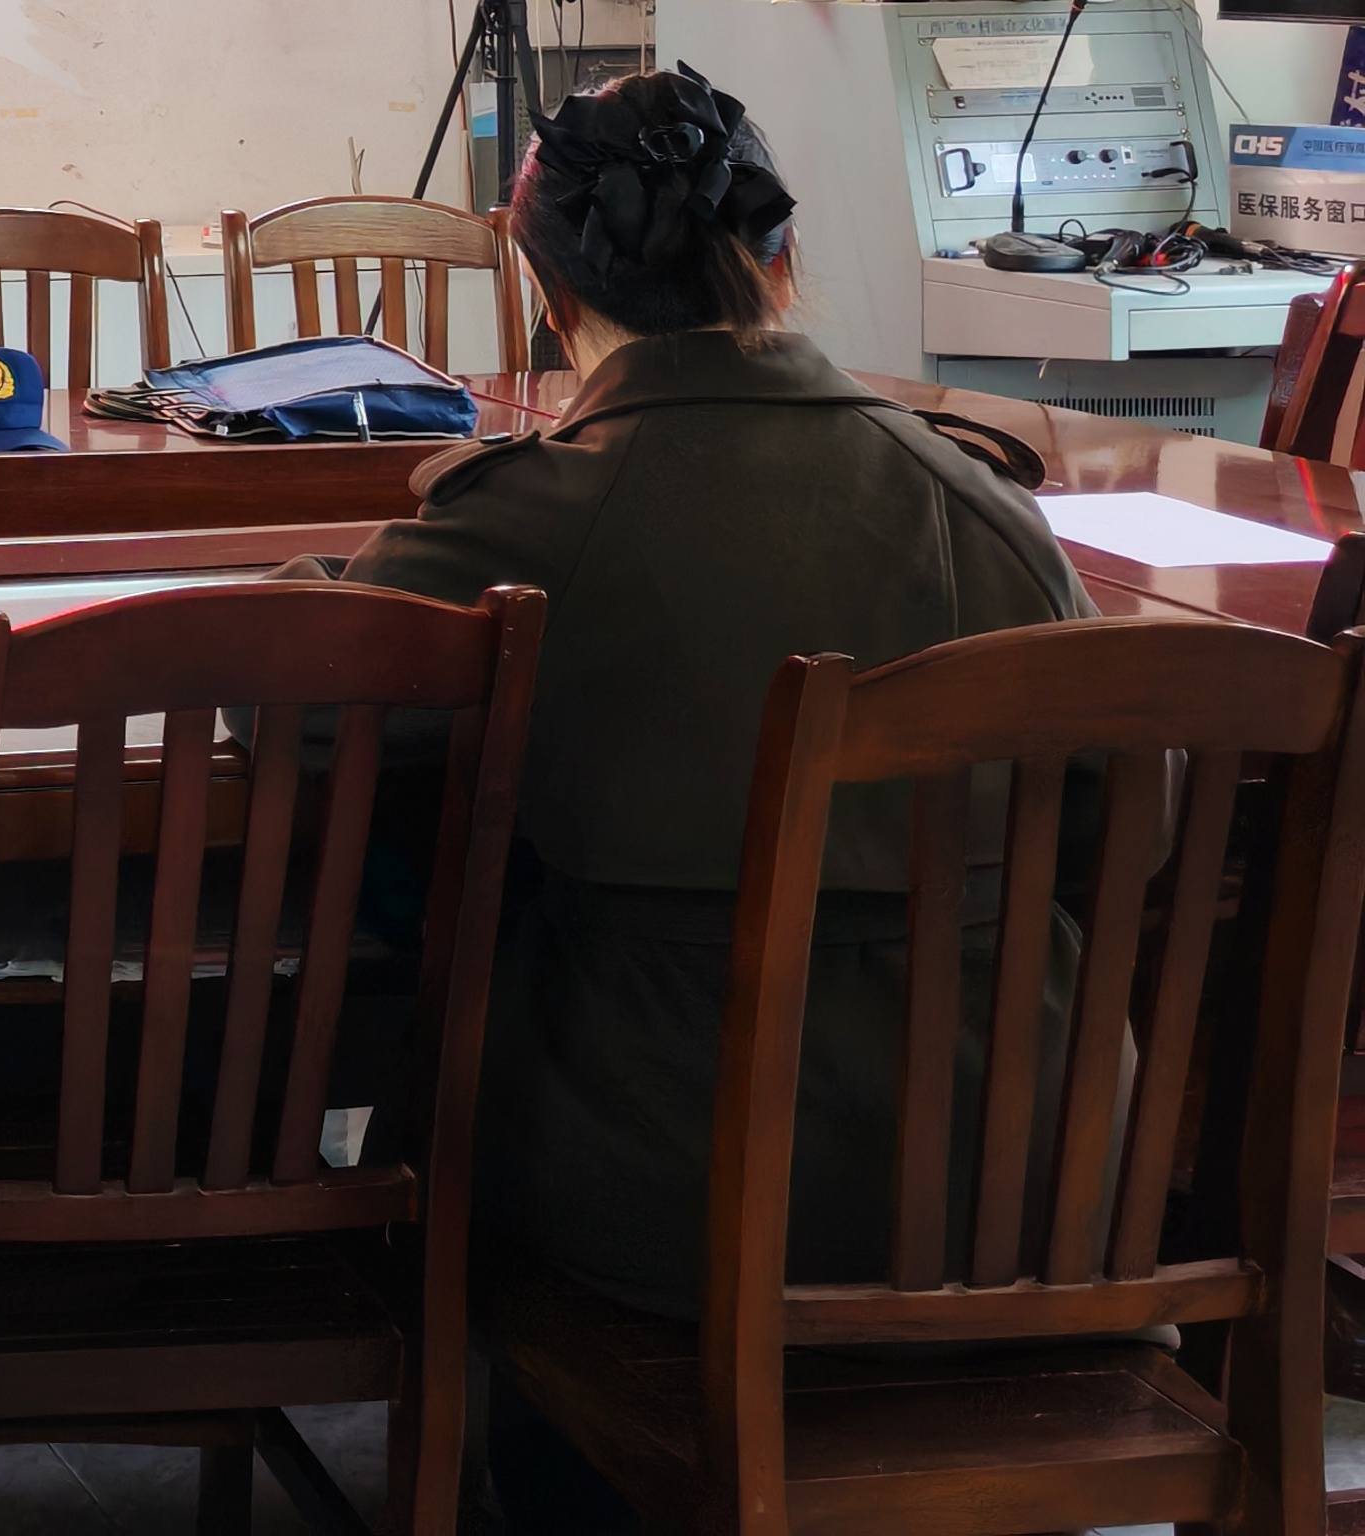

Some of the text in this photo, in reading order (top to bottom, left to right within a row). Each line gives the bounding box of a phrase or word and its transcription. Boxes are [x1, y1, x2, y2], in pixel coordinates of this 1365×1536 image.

[1237, 192, 1365, 224] 医保服务窗口
